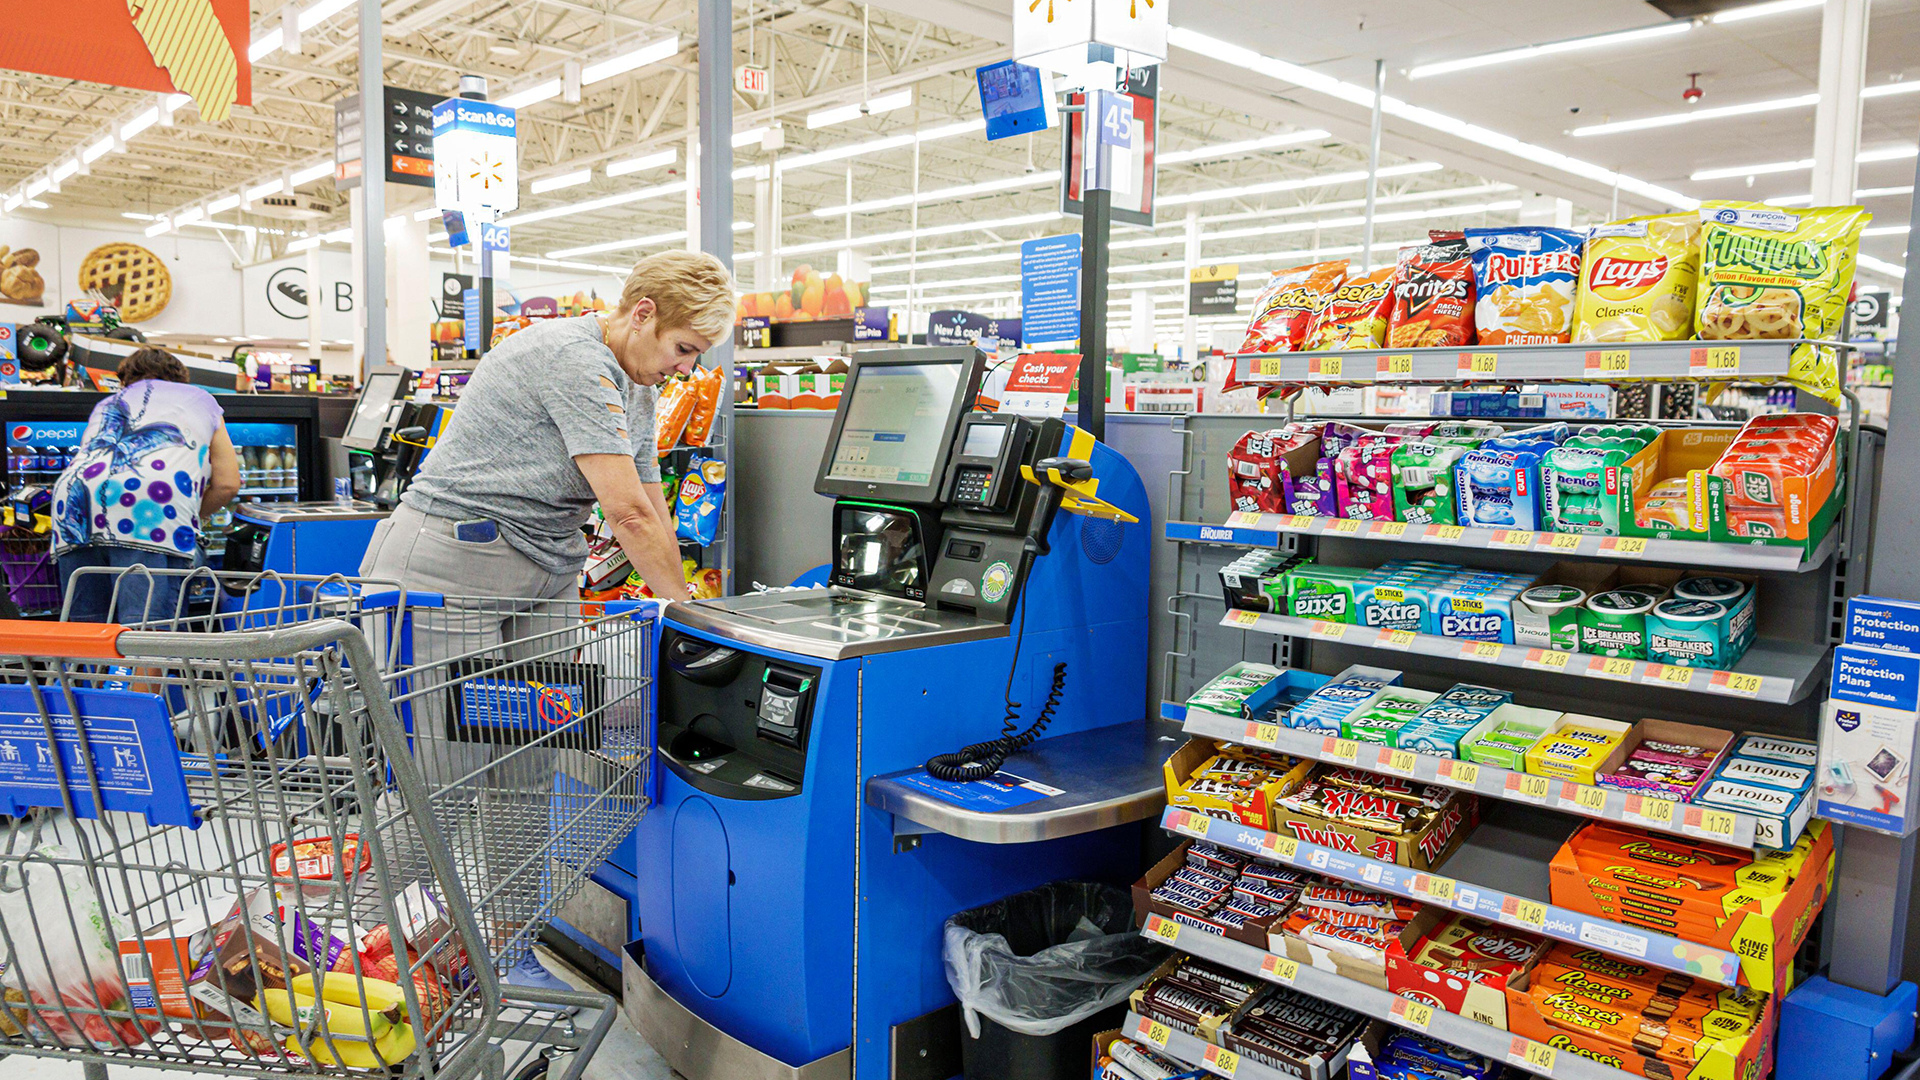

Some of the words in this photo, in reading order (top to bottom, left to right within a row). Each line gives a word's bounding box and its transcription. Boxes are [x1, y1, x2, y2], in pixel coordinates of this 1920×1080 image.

[744, 69, 765, 91] EXIT
[457, 108, 515, 128] Scan&Go
[1104, 104, 1132, 140] 45
[483, 228, 509, 247] 46
[1714, 272, 1736, 280] Onion
[1738, 274, 1776, 284] Flavored
[1433, 308, 1461, 318] CHEESE
[1437, 303, 1462, 312] NACHO
[1596, 305, 1644, 318] Classic
[867, 328, 882, 338] Price
[934, 324, 954, 336] New
[955, 325, 962, 336] &
[963, 327, 983, 338] cool
[1000, 338, 1016, 346] Price
[1023, 363, 1045, 372] Cash
[1044, 366, 1067, 376] your
[1018, 374, 1050, 384] checks
[1575, 391, 1606, 399] ROLLS
[36, 428, 78, 440] pepsi
[1468, 454, 1513, 467] mentos
[1516, 471, 1526, 492] GUM
[1558, 474, 1601, 488] mentos
[1607, 469, 1617, 490] GUM
[1459, 468, 1468, 512] mentos
[1694, 472, 1702, 511] adventure
[1792, 493, 1801, 525] orange
[1694, 511, 1704, 530] fruit
[1200, 527, 1234, 540] ENQUIRER
[1384, 590, 1403, 598] STICKS
[1295, 593, 1346, 615] Extra
[1453, 598, 1462, 606] 35
[1462, 601, 1483, 609] STICKS
[1366, 604, 1420, 626] Extra
[1855, 608, 1883, 617] Walmart
[1442, 616, 1502, 637] Extra
[1518, 626, 1524, 634] 3
[1853, 615, 1919, 633] Protection
[1583, 626, 1598, 640] ICE
[1598, 630, 1641, 645] BREAKERS
[1852, 626, 1886, 640] Plans
[1600, 641, 1625, 650] MINTS
[1651, 635, 1666, 648] ICE
[1667, 640, 1714, 655] BREAKERS
[1669, 650, 1696, 660] MINTS
[1842, 655, 1868, 664] Walmart
[1840, 662, 1904, 682] Protection
[1838, 674, 1871, 688] Plans
[1318, 686, 1372, 699] Extra
[1446, 691, 1503, 702] Extra
[1860, 690, 1866, 698] by
[1866, 690, 1896, 702] Allstate
[35, 717, 92, 727] WRNIG
[1422, 708, 1482, 722] Extra
[1748, 741, 1816, 757] ALTOIDS
[1732, 763, 1802, 780] ALTOIDS
[1714, 785, 1784, 804] ALTOIDS
[1242, 810, 1264, 818] SHARE
[1829, 806, 1850, 816] Walmart
[1856, 812, 1890, 824] PROTECTION
[1249, 818, 1264, 826] SIZE
[1286, 820, 1360, 854] Twix
[1420, 804, 1463, 863] Twix
[1619, 841, 1700, 865] Reese's
[1588, 877, 1620, 892] Reese's
[1602, 865, 1687, 889] Reese's
[1164, 878, 1214, 901] SNICKERS
[1232, 878, 1287, 900] SNICKERS
[1310, 886, 1388, 905] PAYDAY
[1591, 926, 1626, 939] DOWNLOAD
[1740, 938, 1769, 953] KING
[1738, 947, 1766, 961] SIZE
[1555, 970, 1634, 1002] Reese's
[1154, 985, 1223, 1018] HERSHEY'S
[1260, 998, 1345, 1036] HERSHEY'S
[1543, 992, 1622, 1027] Reese's
[1472, 1010, 1494, 1025] KING
[1394, 1048, 1424, 1063] Almond
